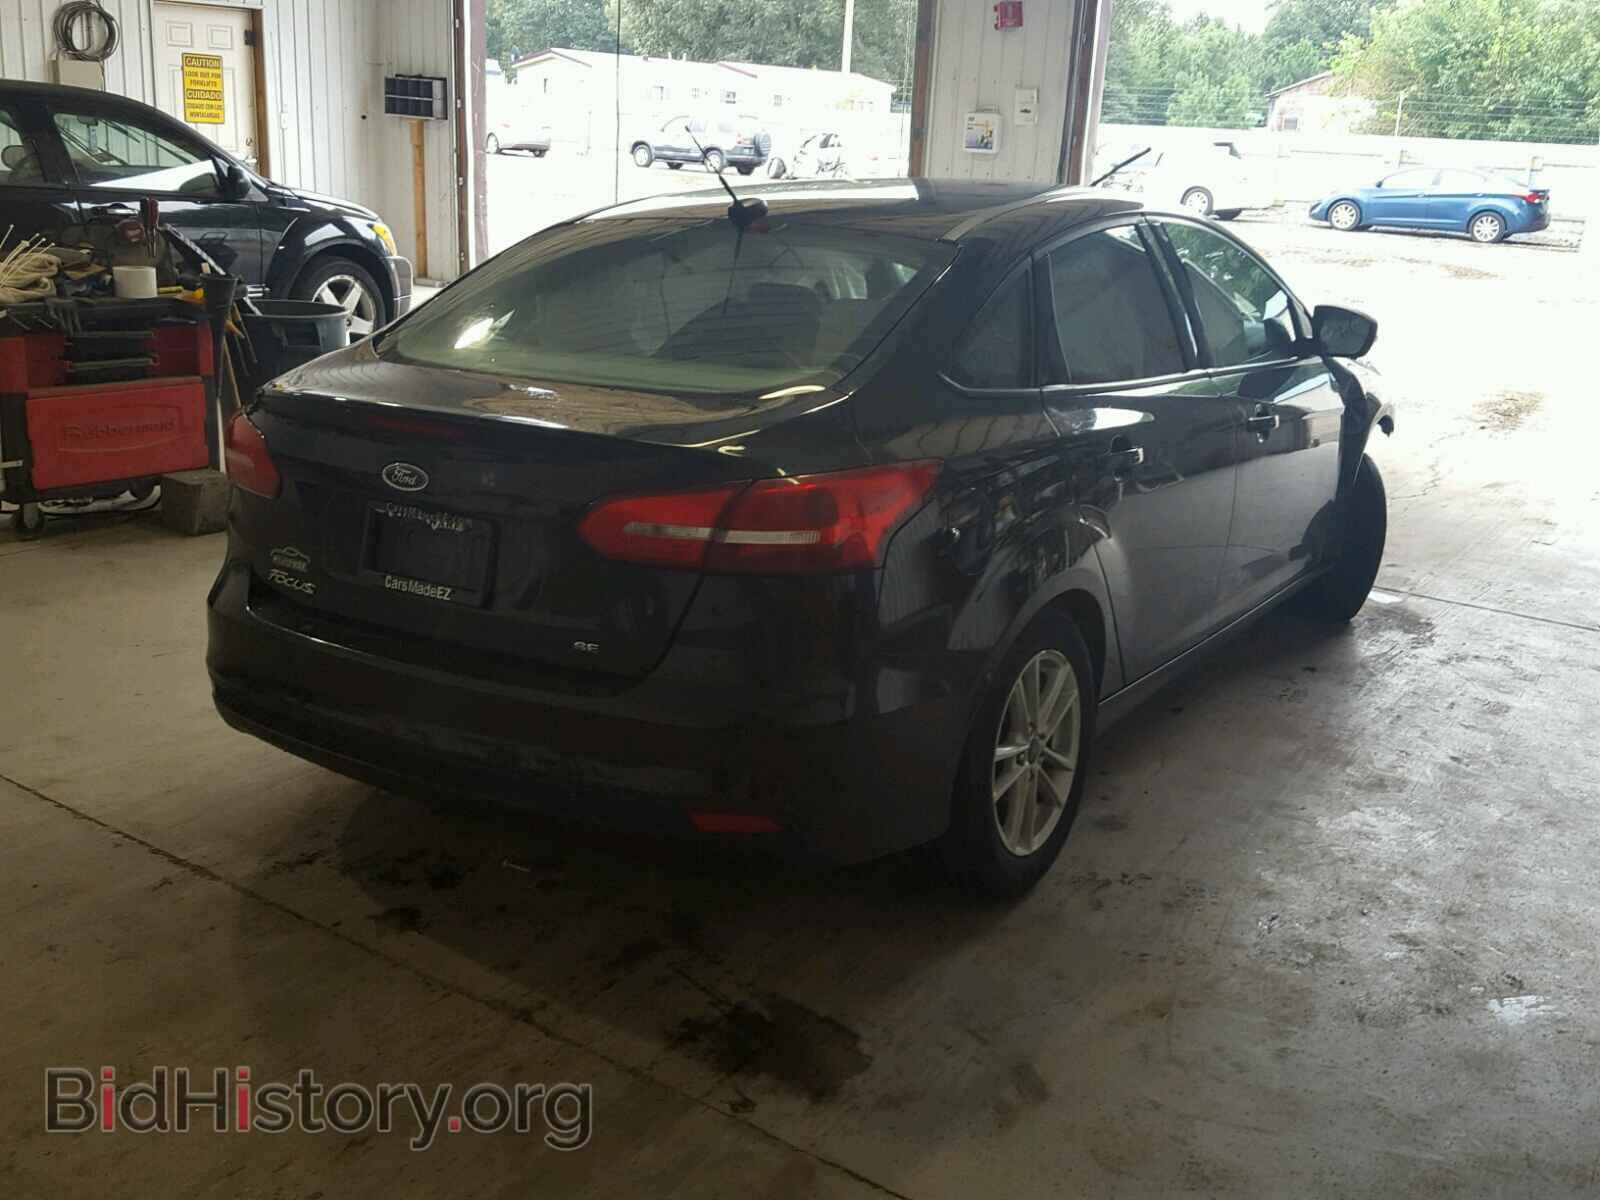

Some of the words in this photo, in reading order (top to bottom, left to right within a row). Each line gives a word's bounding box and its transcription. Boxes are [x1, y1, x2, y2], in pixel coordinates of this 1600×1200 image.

[185, 56, 221, 68] CAUTION
[186, 90, 222, 100] CUIDADO
[384, 575, 452, 601] CarsMadeEZ
